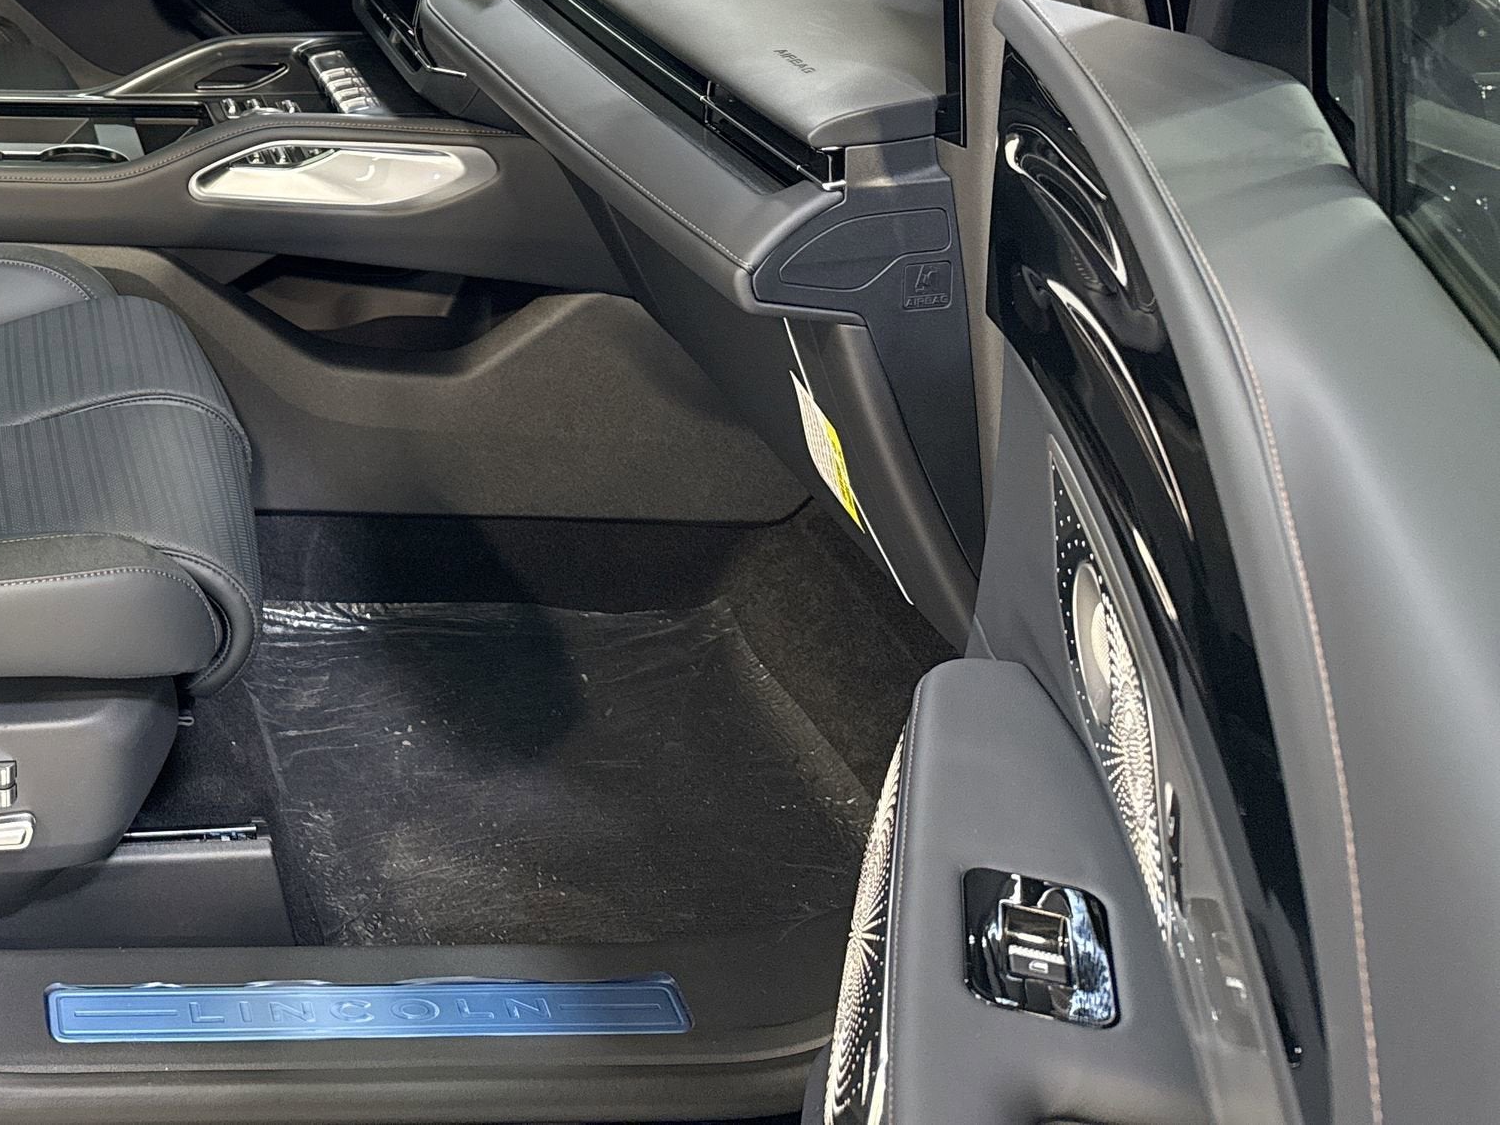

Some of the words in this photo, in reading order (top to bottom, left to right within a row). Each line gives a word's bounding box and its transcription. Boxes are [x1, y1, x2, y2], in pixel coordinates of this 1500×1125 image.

[774, 48, 816, 74] AIRBAG
[905, 295, 949, 307] AIRBAG
[188, 998, 551, 1023] LINCOLN
